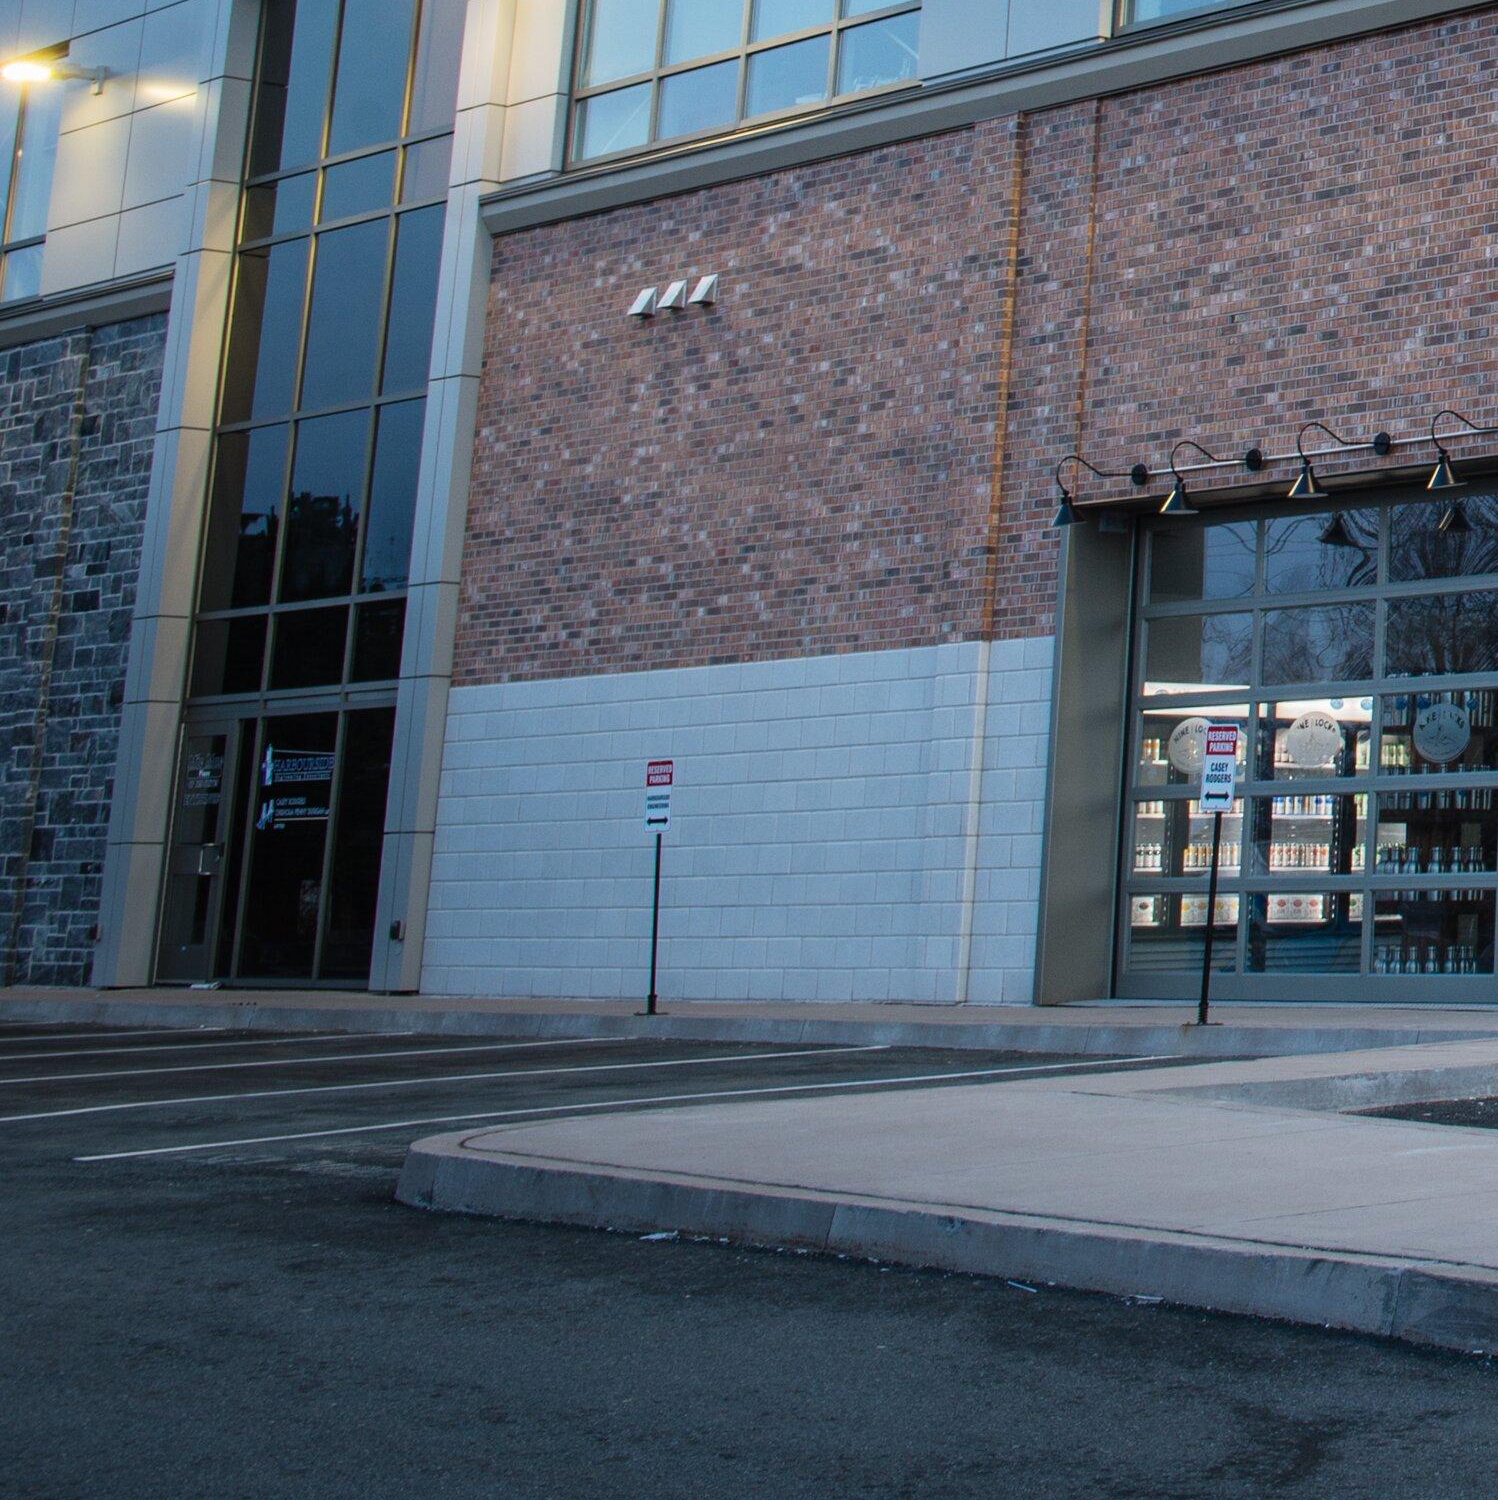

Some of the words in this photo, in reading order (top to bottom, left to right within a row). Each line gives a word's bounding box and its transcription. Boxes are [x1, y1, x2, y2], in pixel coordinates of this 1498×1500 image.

[1208, 730, 1237, 741] RESERVED
[1209, 741, 1234, 752] PARKING
[1210, 762, 1229, 772] CASEY
[1205, 773, 1232, 783] RODGERS
